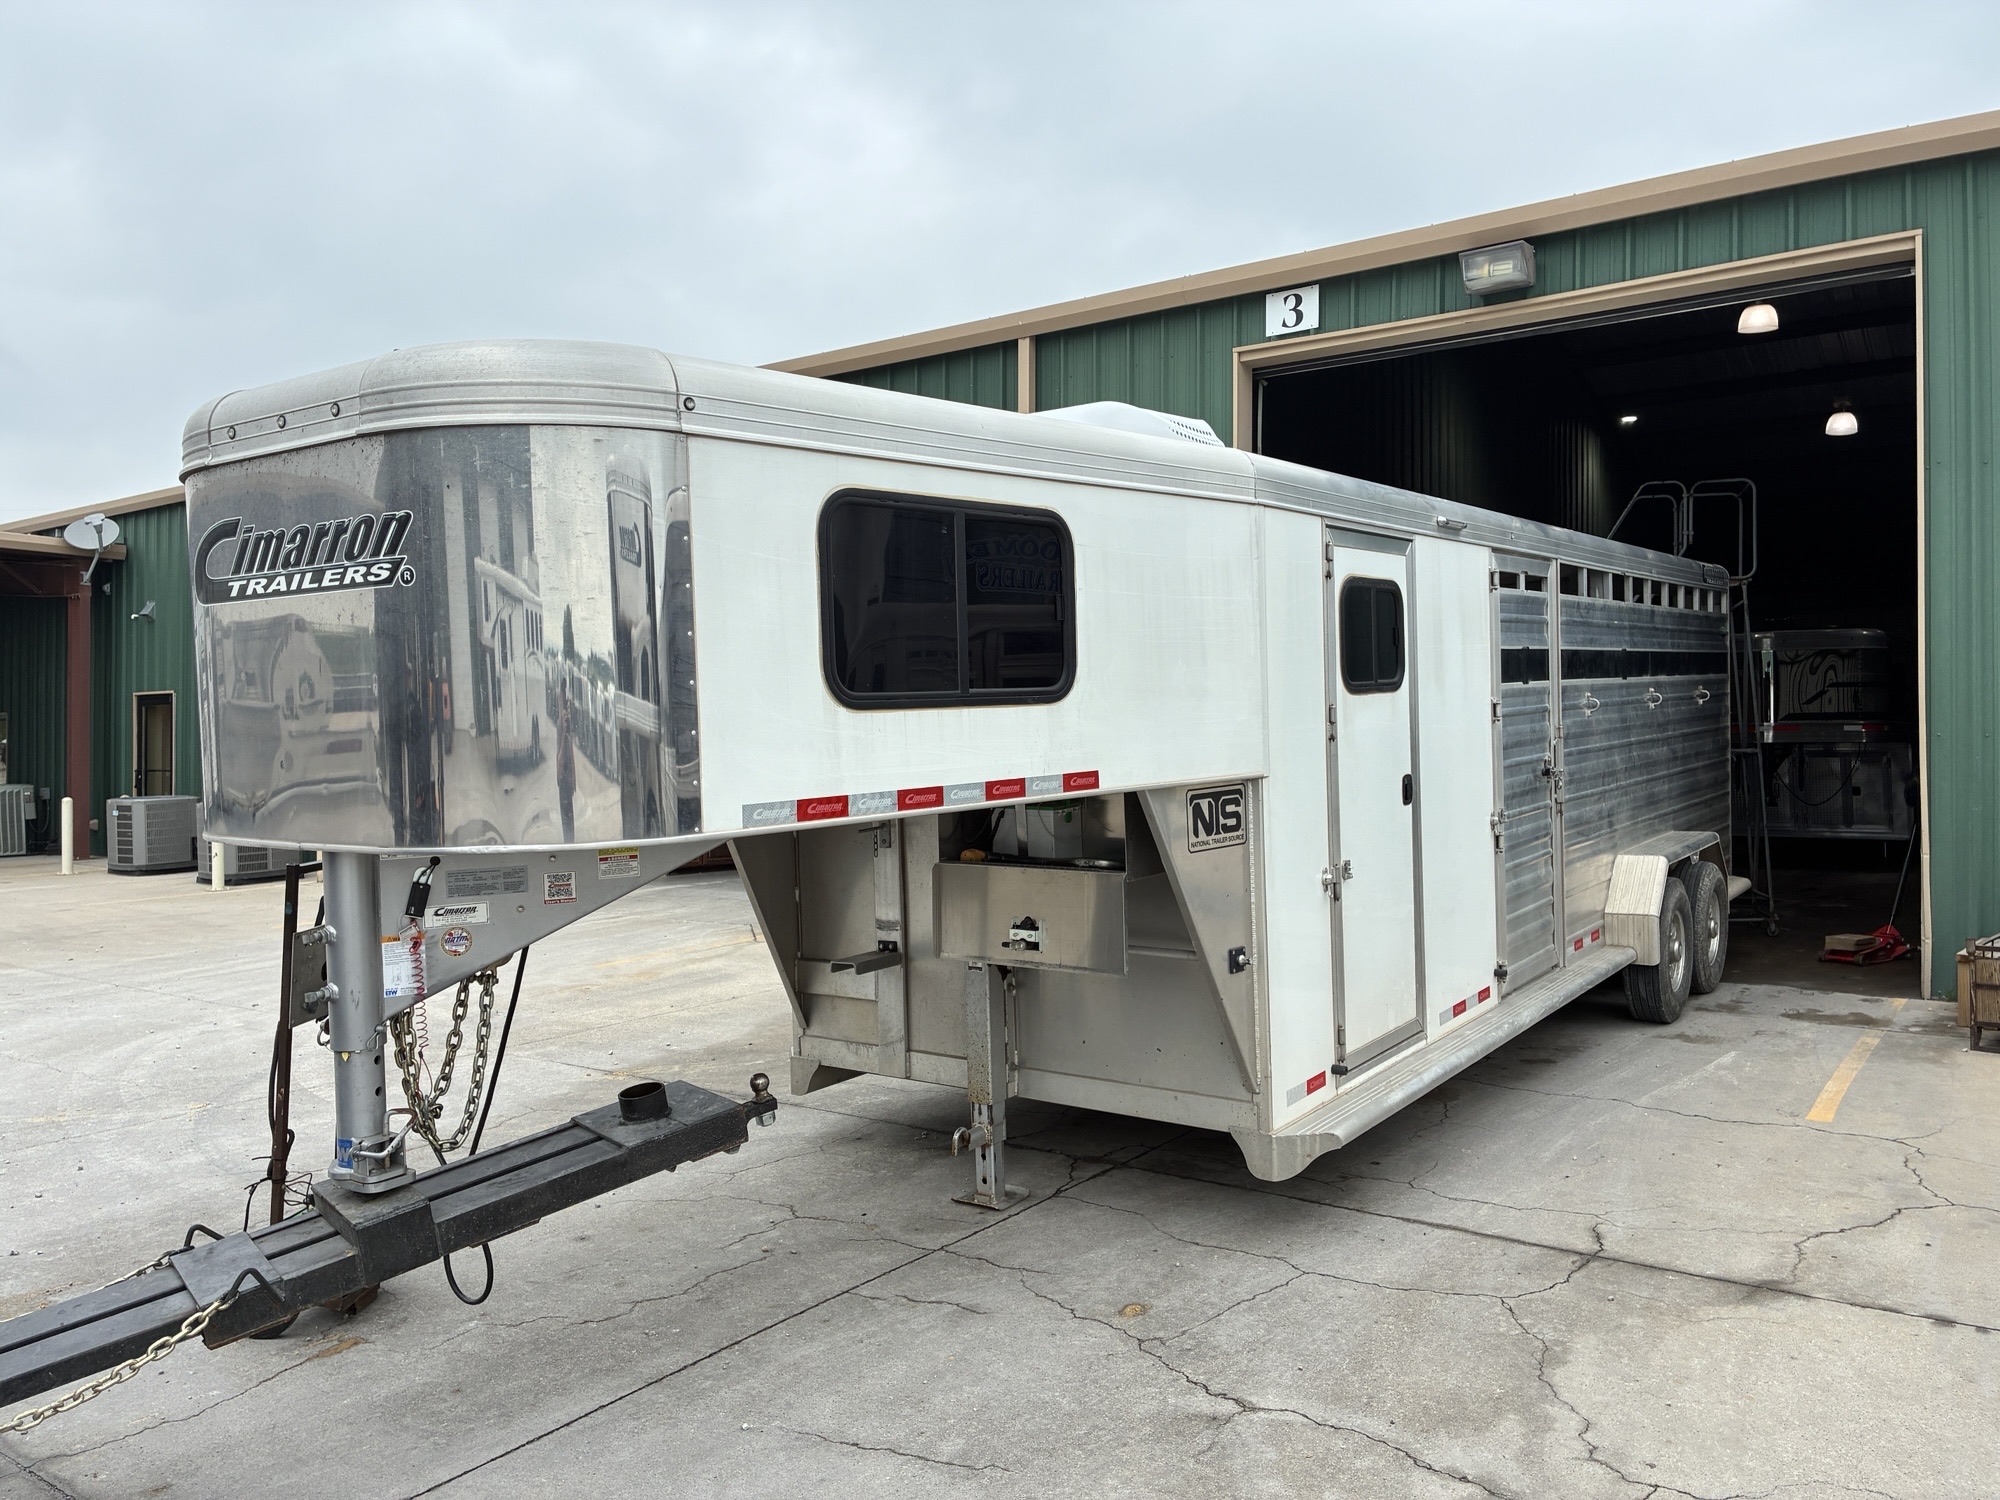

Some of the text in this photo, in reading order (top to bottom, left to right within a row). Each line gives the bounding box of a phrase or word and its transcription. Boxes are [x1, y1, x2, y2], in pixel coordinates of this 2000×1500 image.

[1282, 293, 1303, 328] 3
[195, 510, 413, 582] Cimarron
[228, 563, 392, 597] TRAILERS
[1191, 834, 1245, 848] NATIONAL TRAILER SOURCE
